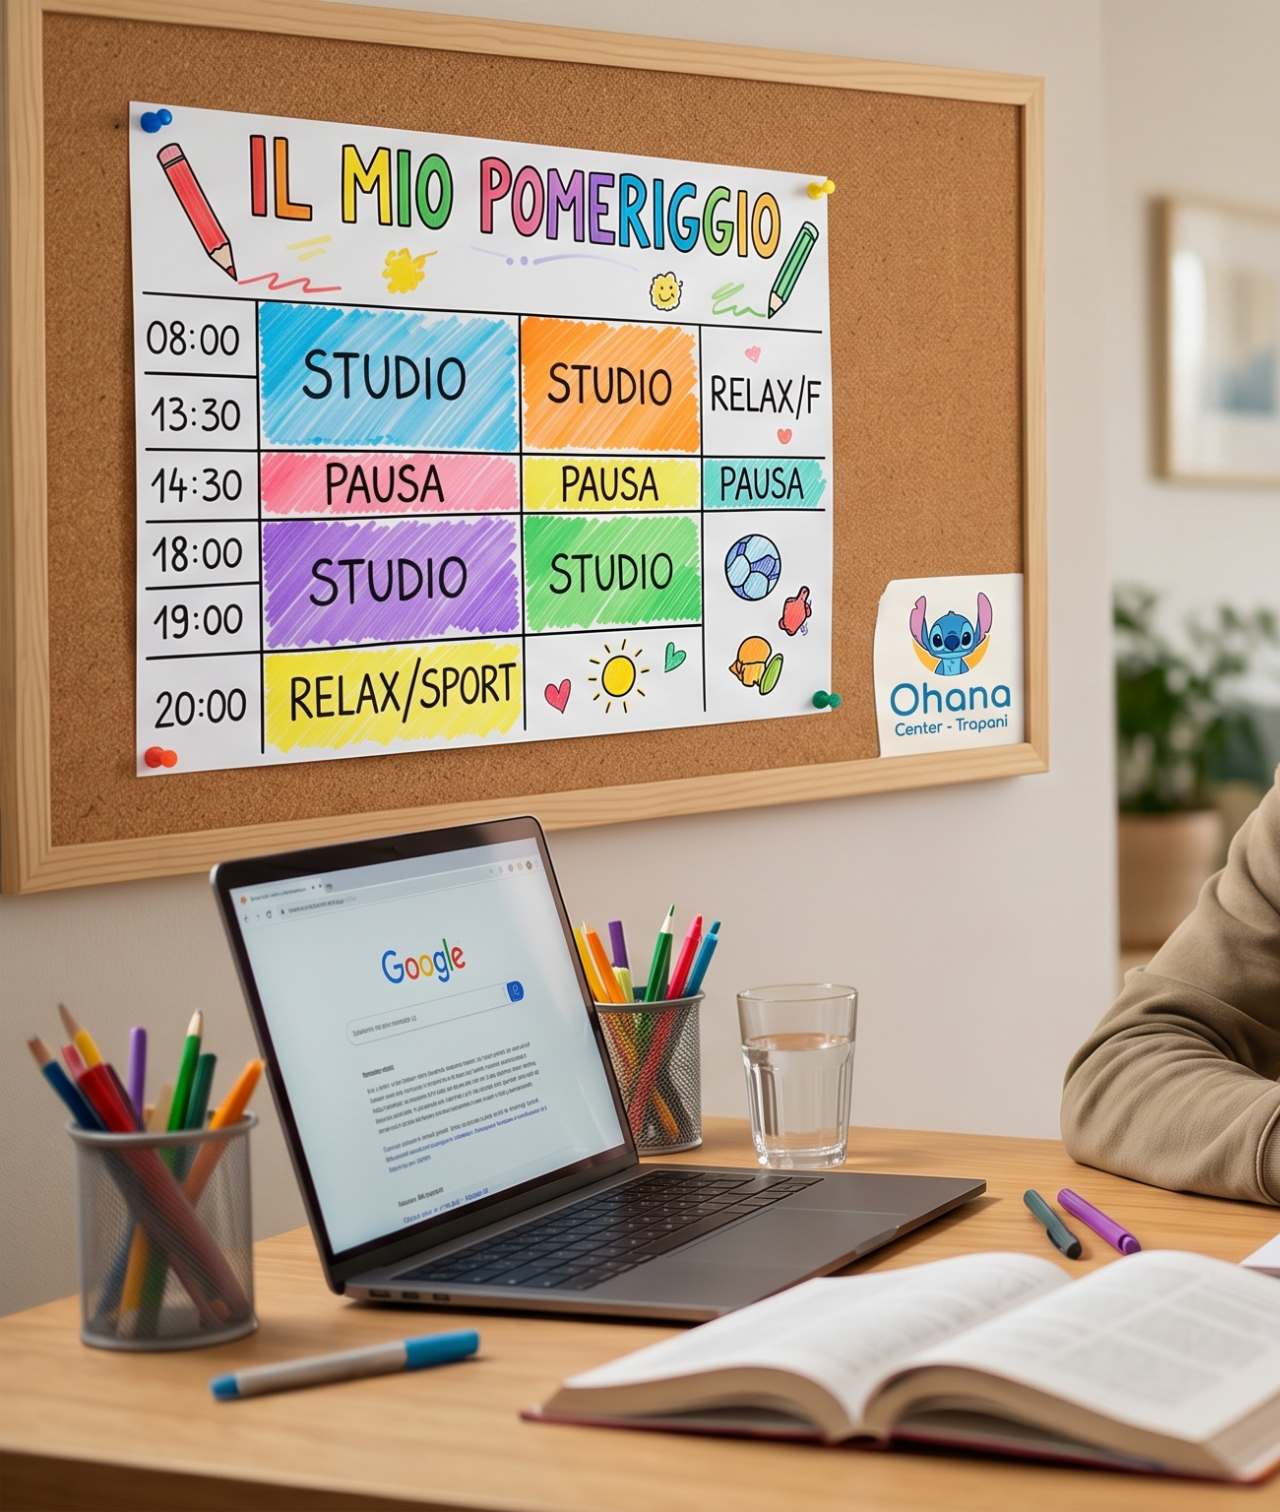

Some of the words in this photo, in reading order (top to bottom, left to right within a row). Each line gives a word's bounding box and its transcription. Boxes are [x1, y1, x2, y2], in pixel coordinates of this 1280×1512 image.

[249, 134, 313, 222] IL
[341, 143, 454, 231] MIO
[479, 156, 782, 260] POMERIGGIO
[146, 320, 240, 356] 08:00
[302, 348, 466, 401] STUDIO
[547, 362, 672, 406] STUDIO
[151, 396, 241, 432] 13:30
[711, 374, 822, 420] RELAX/F
[151, 467, 243, 504] 14:30
[326, 462, 445, 506] PAUSA
[562, 465, 659, 503] PAUSA
[720, 465, 805, 502] PAUSA
[152, 535, 243, 573] 18:00
[549, 552, 673, 595] STUDIO
[309, 555, 468, 607] STUDIO
[153, 603, 243, 640] 19:00
[154, 687, 247, 729] 20:00
[291, 657, 517, 724] RELAX/SPORT
[890, 682, 1011, 716] Ohana
[895, 722, 943, 737] Center
[381, 938, 466, 984] Google
